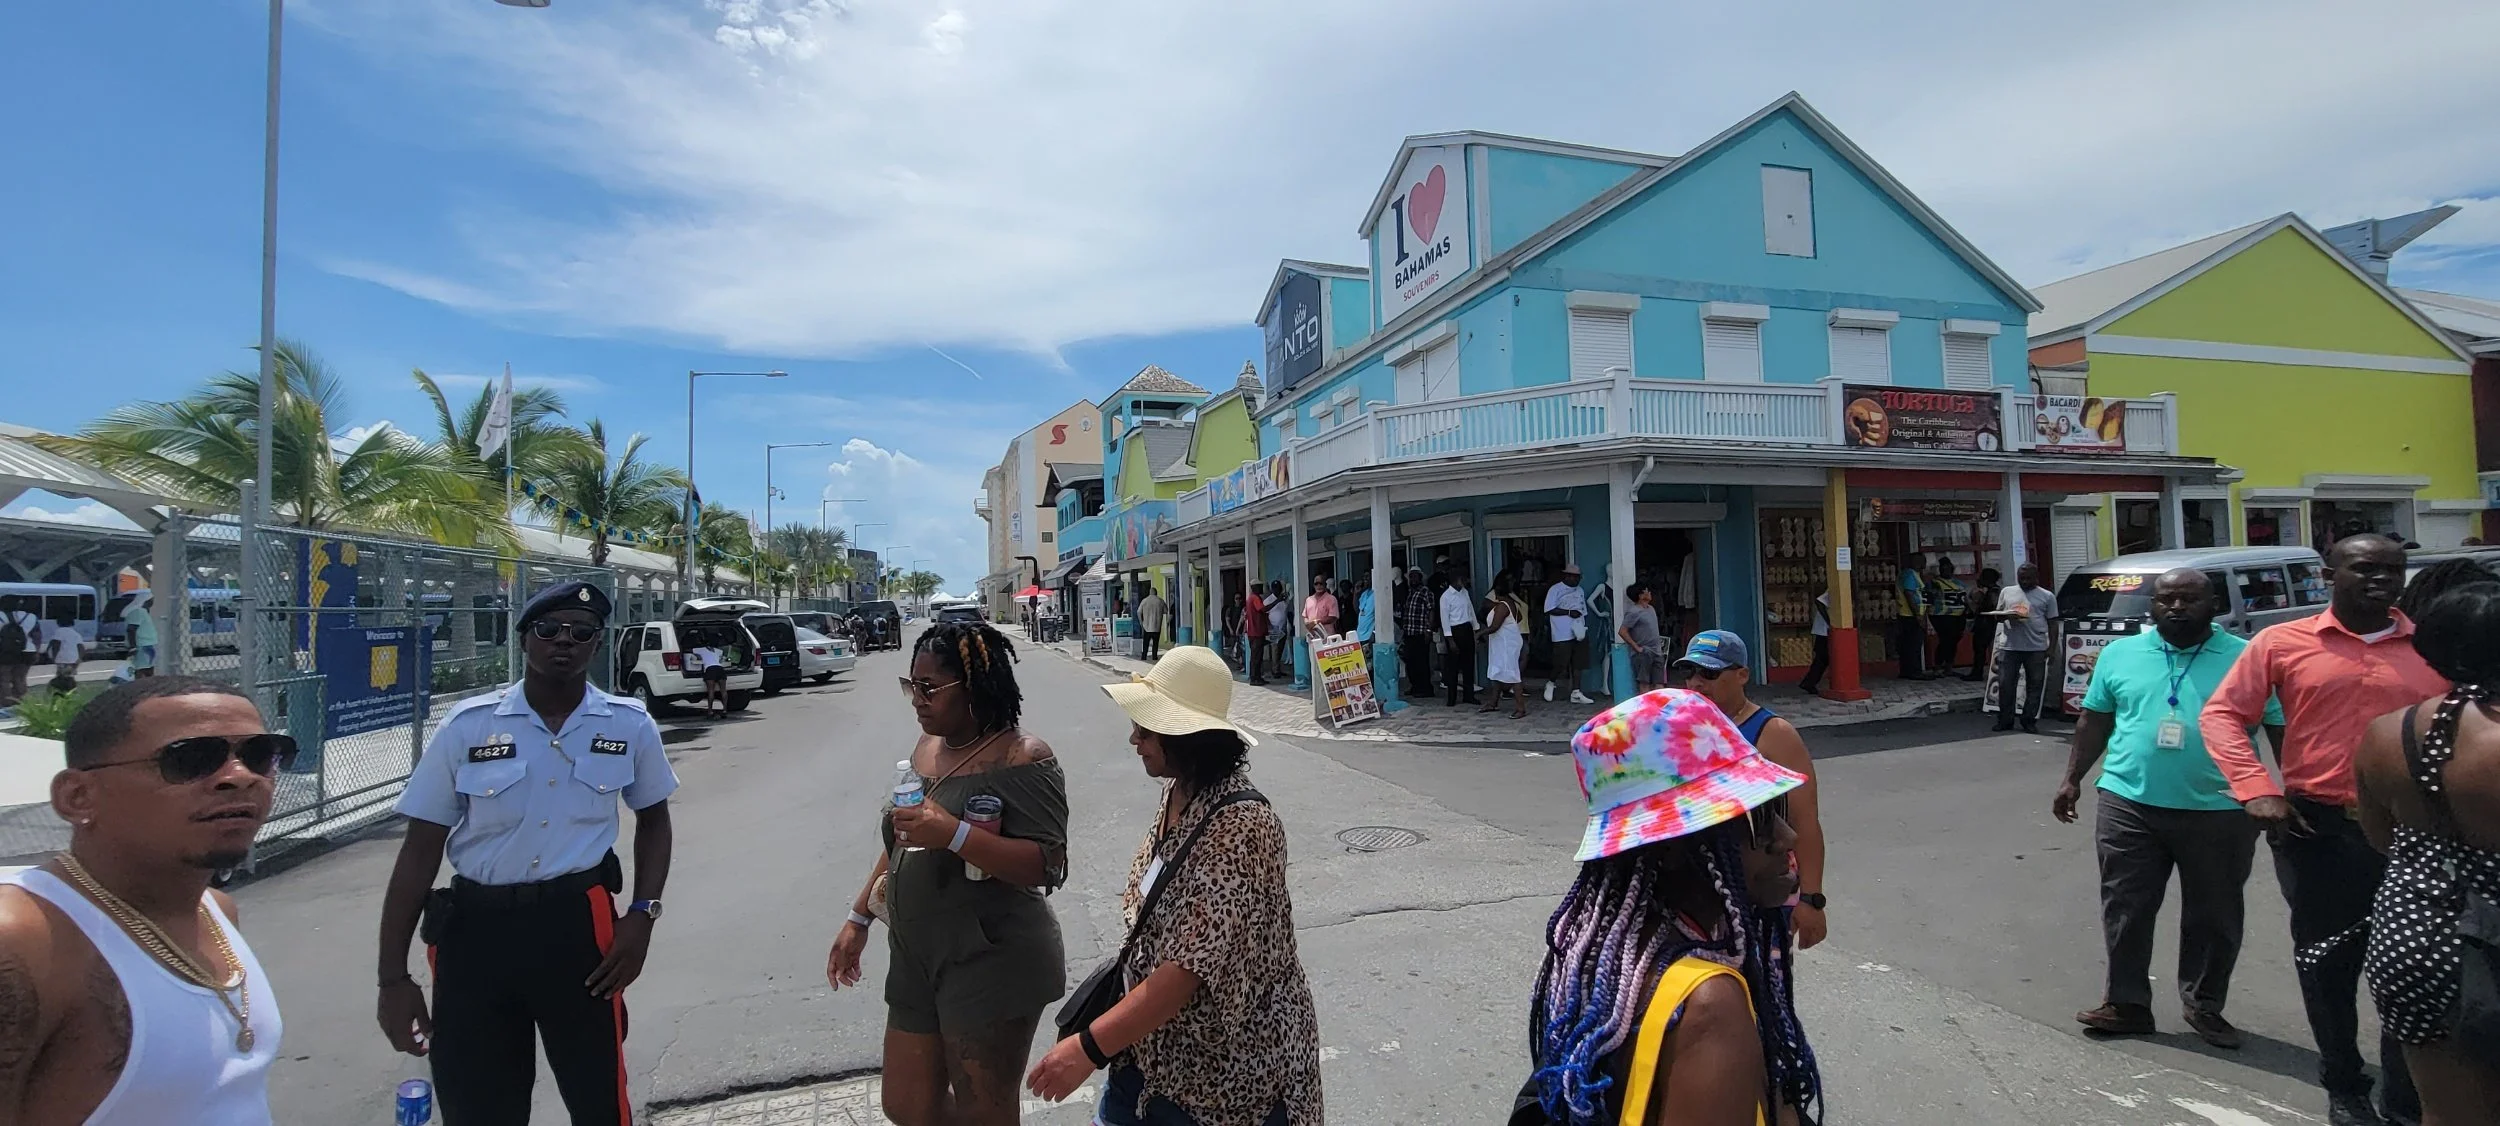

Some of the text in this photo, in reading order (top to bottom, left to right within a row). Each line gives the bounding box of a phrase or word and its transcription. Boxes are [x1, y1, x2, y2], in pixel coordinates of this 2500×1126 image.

[1391, 193, 1409, 267] I
[1395, 236, 1450, 289] BAHAMAS
[1403, 270, 1439, 301] SOUVENIRS
[1882, 391, 1976, 413] TORTUGA
[2049, 397, 2080, 408] BACARDI
[1900, 416, 1961, 426] The Caribbean's
[1892, 428, 1925, 439] Original
[1927, 430, 1933, 438] &
[2089, 575, 2143, 591] Rich's
[1323, 644, 1355, 657] CIGARS
[474, 746, 510, 759] 4627
[594, 740, 626, 752] 4627
